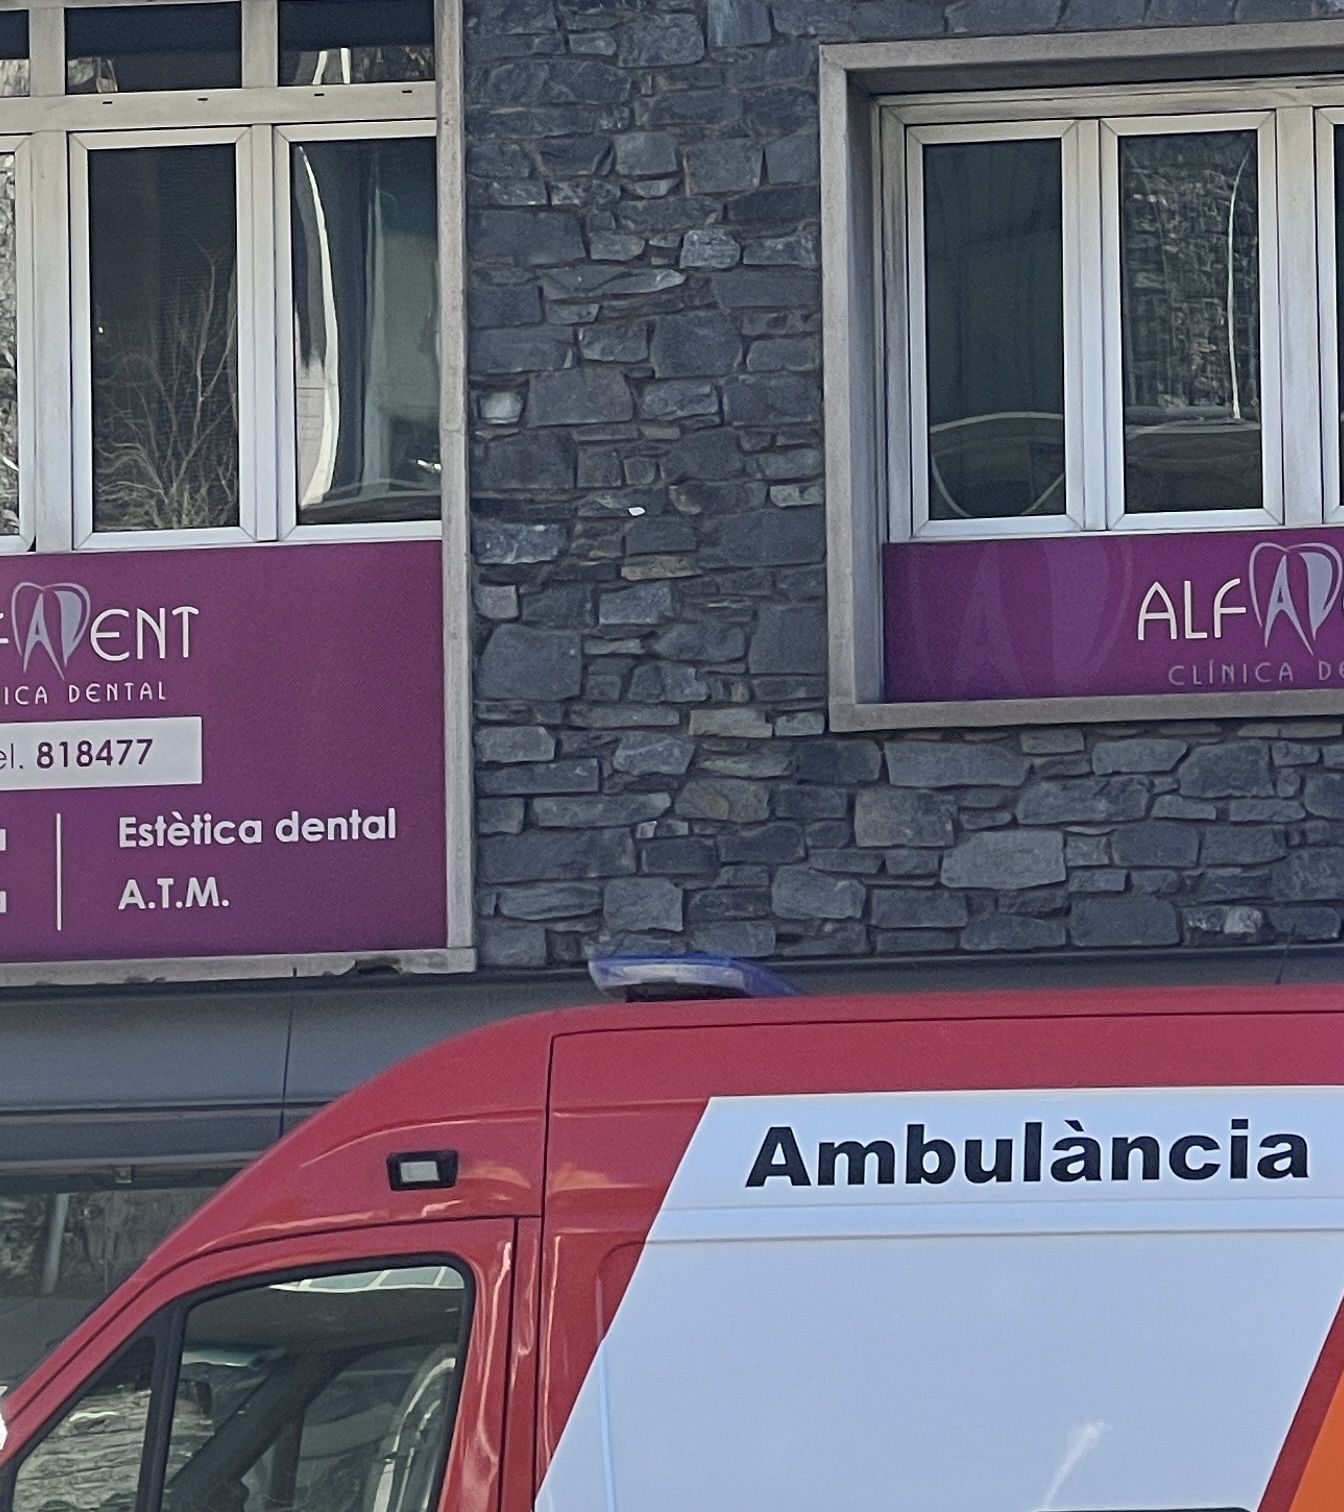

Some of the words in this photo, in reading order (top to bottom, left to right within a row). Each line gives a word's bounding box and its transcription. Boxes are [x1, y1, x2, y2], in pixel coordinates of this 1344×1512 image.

[1168, 658, 1295, 687] CLÍNICA
[68, 681, 167, 704] DENTAL
[35, 738, 154, 770] 818477
[118, 811, 263, 849] Estètica
[274, 808, 398, 845] dental
[118, 876, 231, 913] A.T.M.
[744, 1118, 1310, 1188] Ambulància
